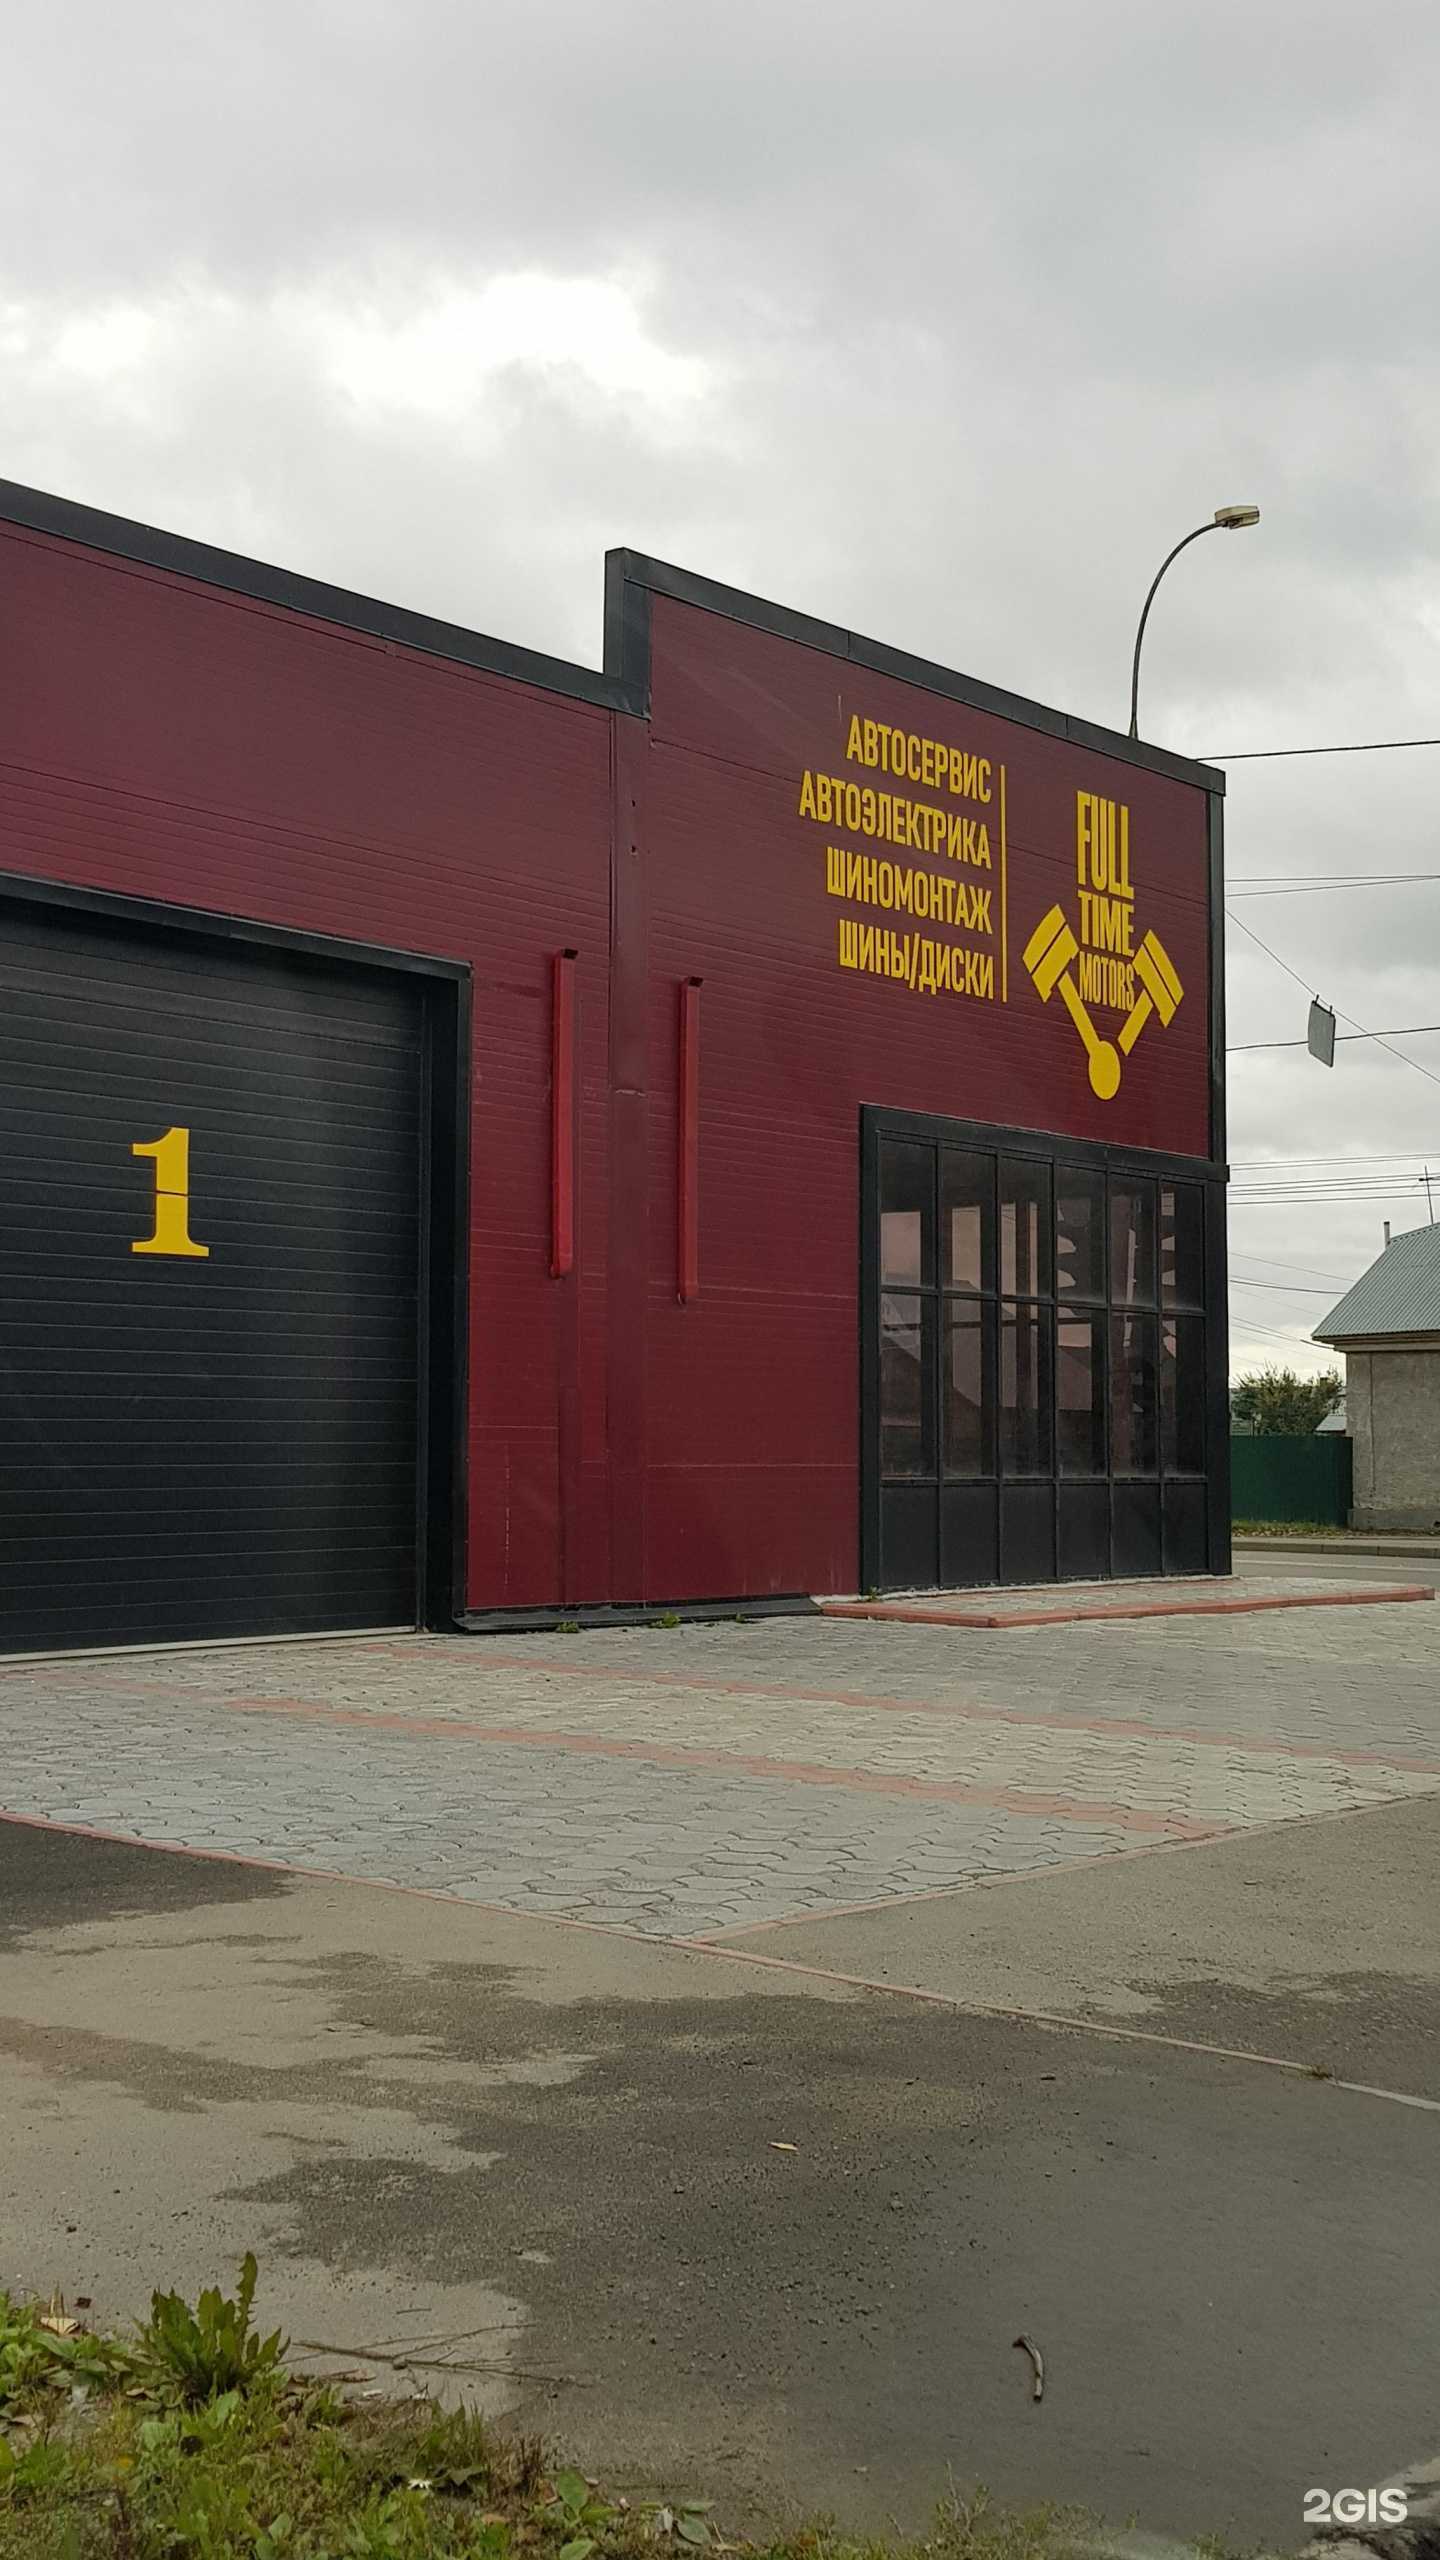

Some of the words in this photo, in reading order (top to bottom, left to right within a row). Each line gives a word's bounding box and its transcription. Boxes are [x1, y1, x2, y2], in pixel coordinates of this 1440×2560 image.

[846, 714, 992, 804] АВТОСЕРВИС
[799, 770, 992, 869] АВТОЭЛЕКТРИКА
[1077, 790, 1135, 900] FULL
[826, 846, 993, 934] ШИНОМОНТАЖ
[1077, 889, 1135, 957] TIME
[839, 918, 994, 1000] ШИНЫ/ДИСКИ
[1079, 951, 1135, 1012] MOTORS
[131, 1127, 210, 1258] 1
